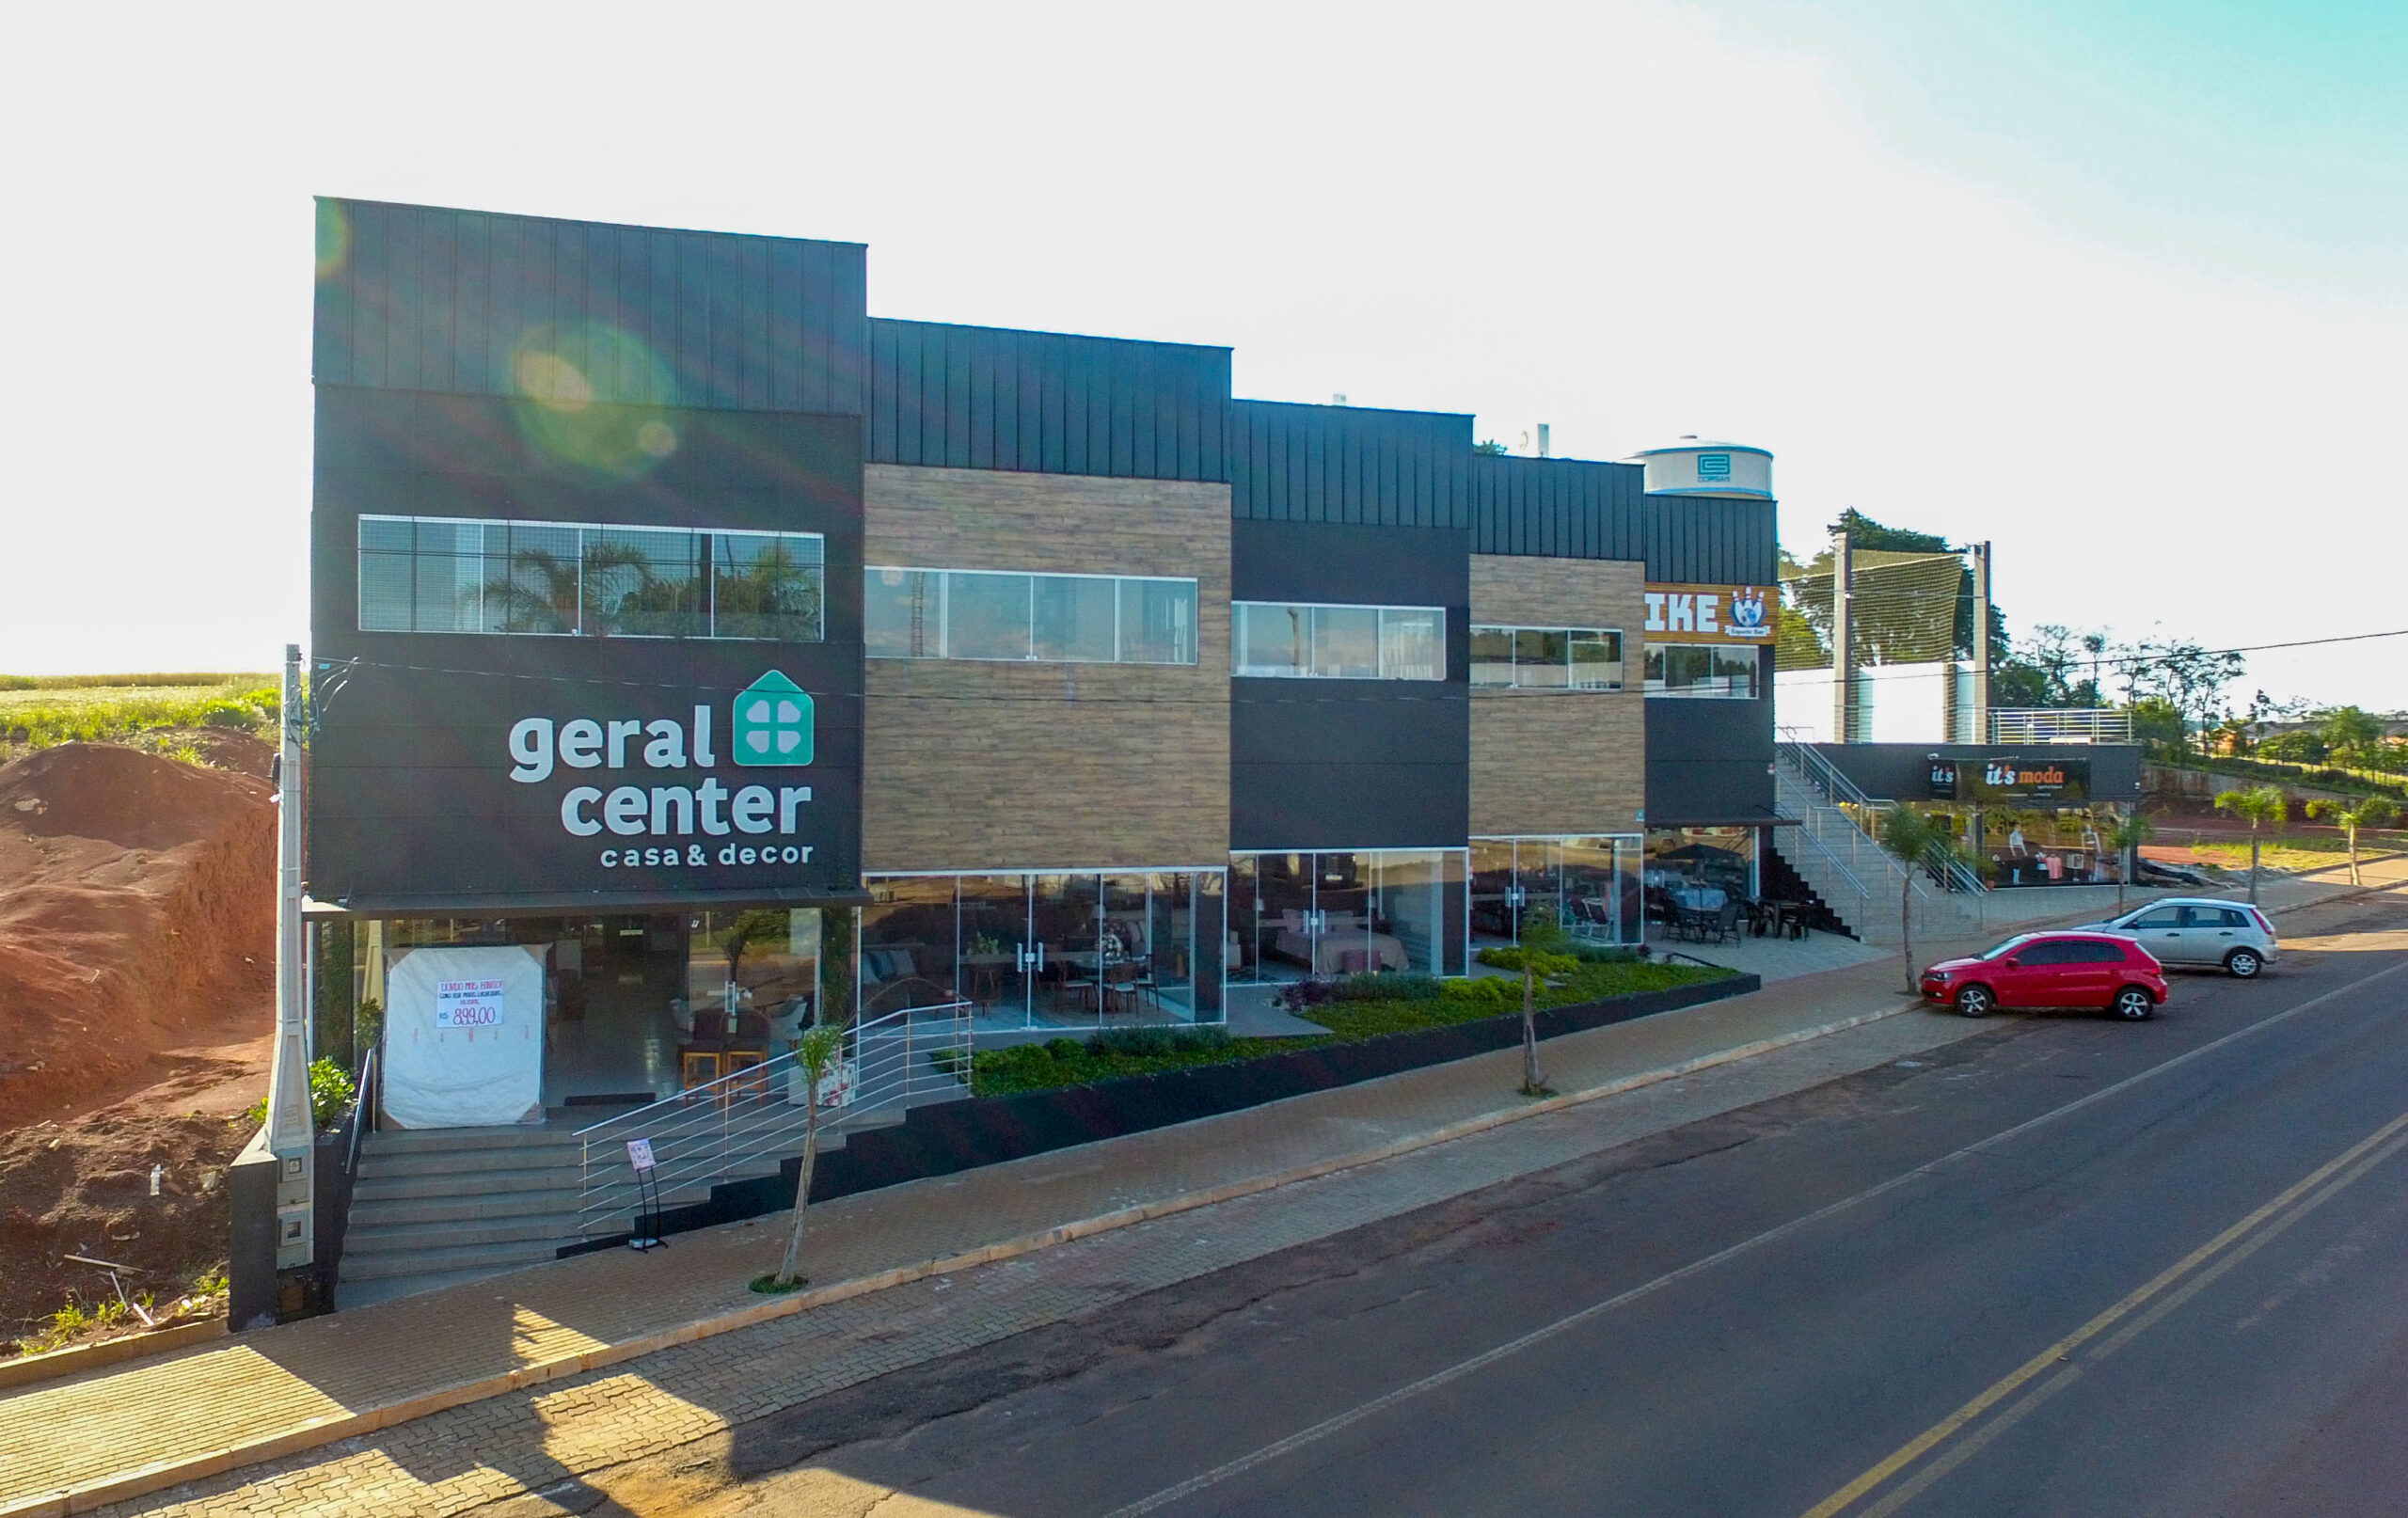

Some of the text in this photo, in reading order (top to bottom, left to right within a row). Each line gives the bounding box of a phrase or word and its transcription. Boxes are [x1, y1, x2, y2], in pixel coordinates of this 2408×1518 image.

[509, 704, 715, 783] geral
[1931, 766, 1954, 783] it's
[1986, 763, 2065, 784] it's moda
[562, 777, 812, 836] center
[600, 843, 814, 868] casa & decor
[453, 1006, 496, 1025] 899,00
